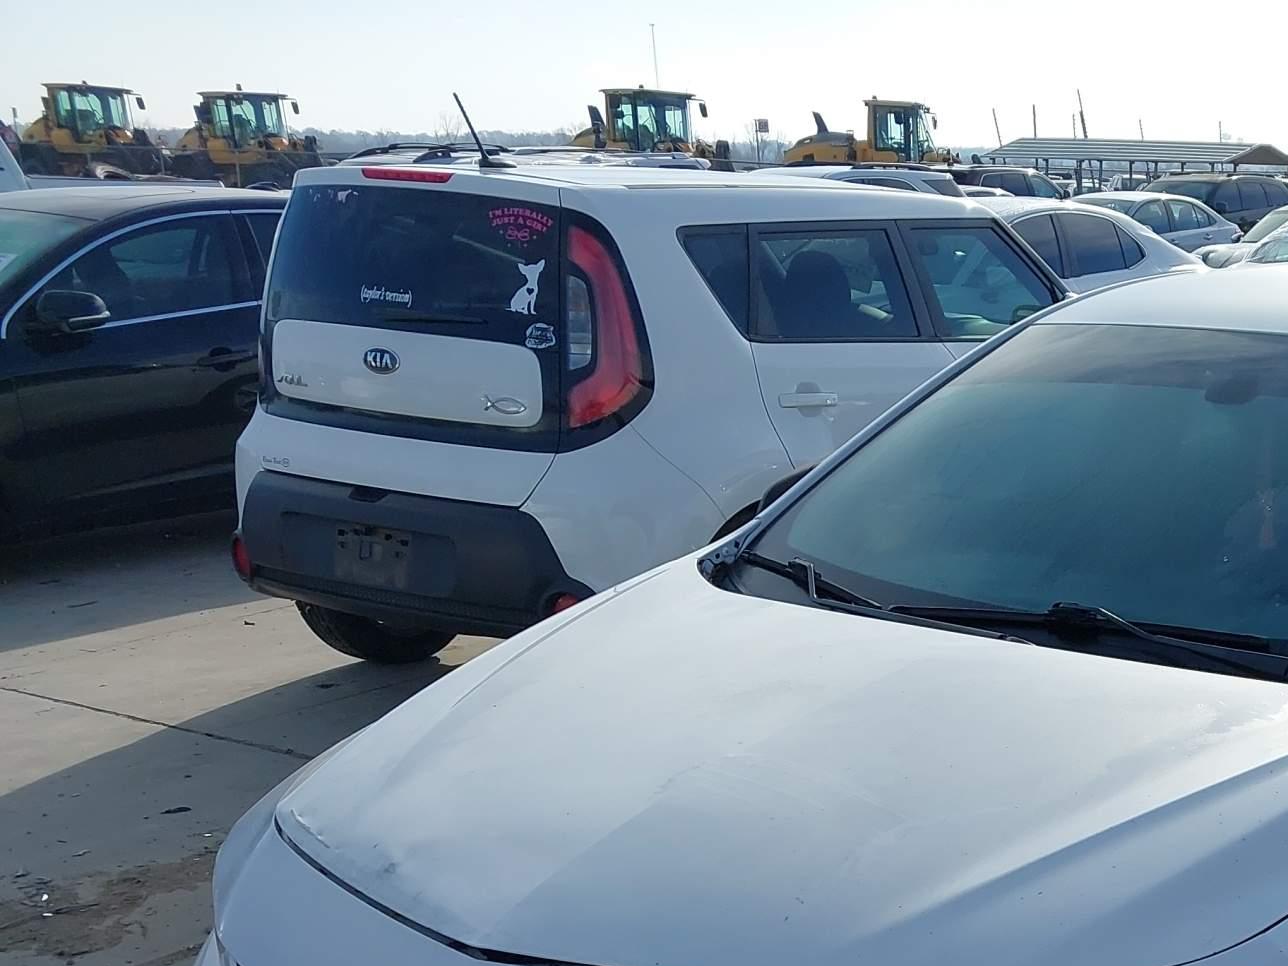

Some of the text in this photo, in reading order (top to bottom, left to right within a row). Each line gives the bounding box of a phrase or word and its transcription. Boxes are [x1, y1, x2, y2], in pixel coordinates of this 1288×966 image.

[489, 207, 554, 227] I'M LITERALLY
[492, 216, 515, 226] JUST
[517, 216, 525, 225] A
[366, 351, 393, 369] KIA
